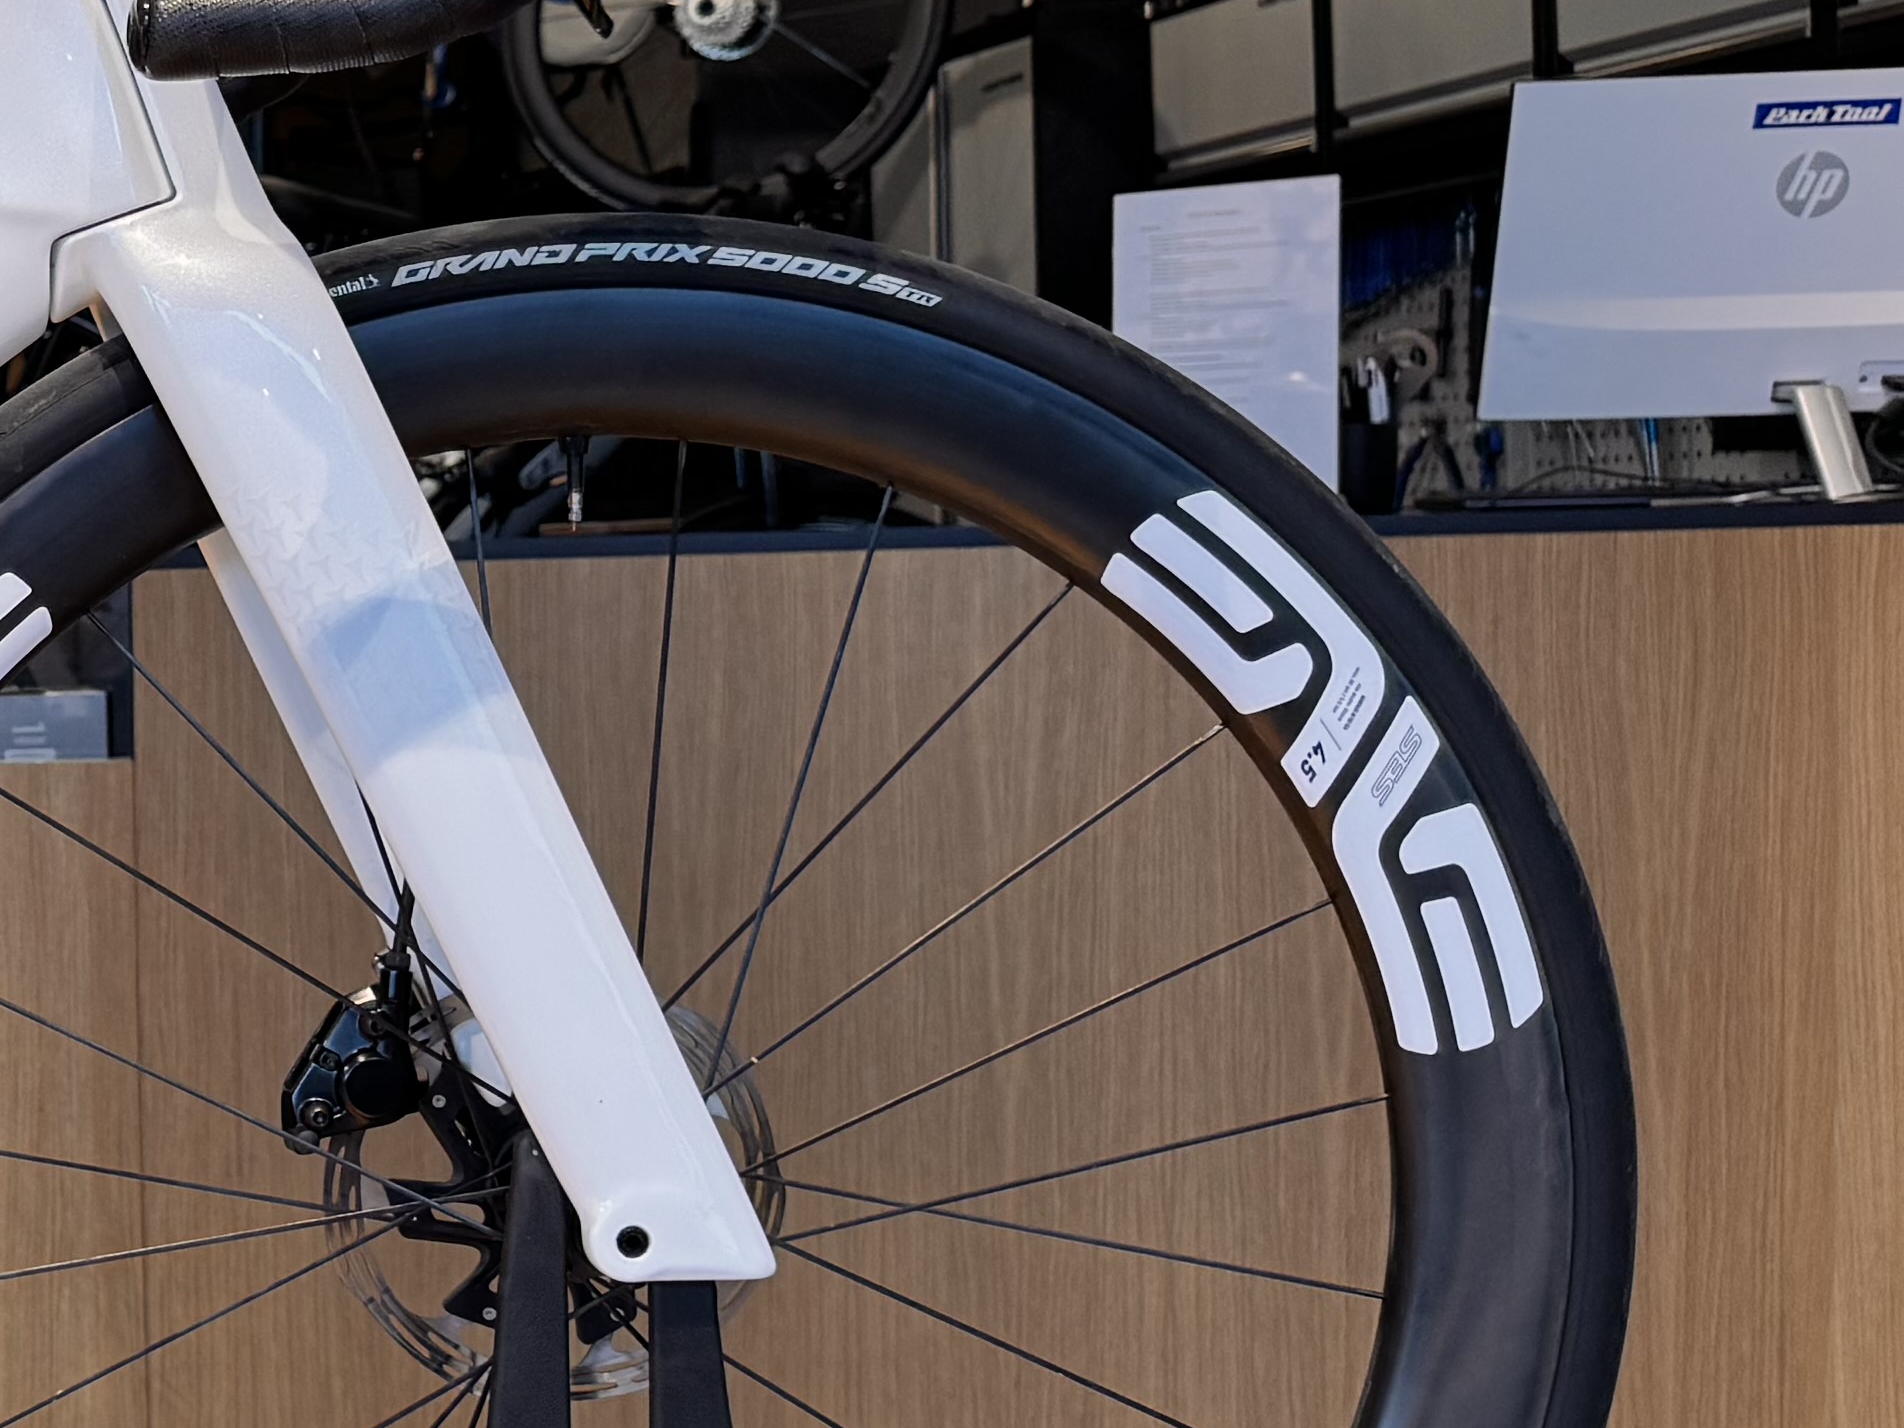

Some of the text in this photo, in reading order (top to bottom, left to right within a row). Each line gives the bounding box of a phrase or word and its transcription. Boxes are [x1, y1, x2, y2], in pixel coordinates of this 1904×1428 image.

[1762, 103, 1893, 125] Park Tool
[1780, 150, 1847, 219] hp
[391, 243, 576, 288] GRAND
[573, 242, 714, 264] PRIX
[707, 246, 868, 286] 5000
[1300, 740, 1327, 784] 4.5
[1371, 724, 1423, 808] SES
